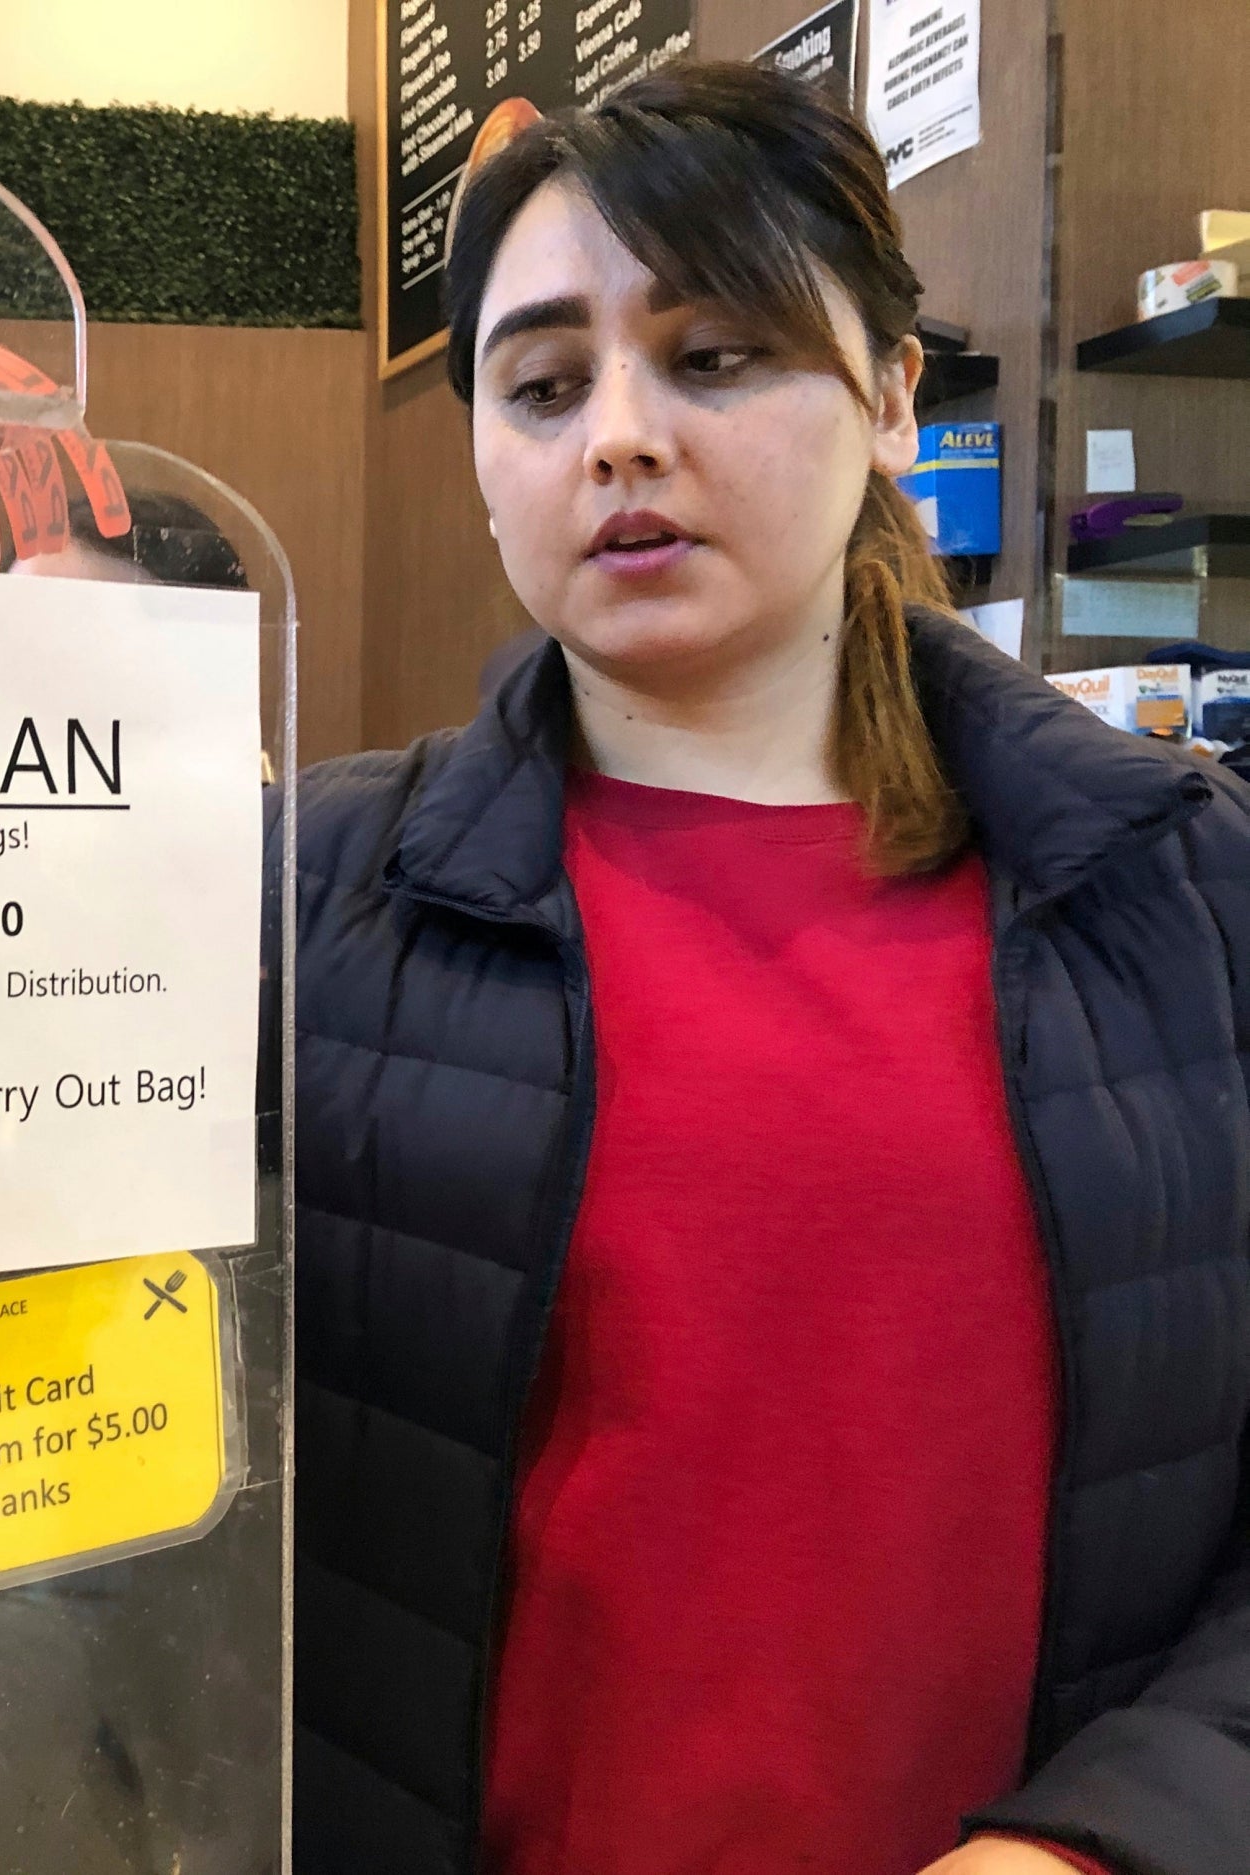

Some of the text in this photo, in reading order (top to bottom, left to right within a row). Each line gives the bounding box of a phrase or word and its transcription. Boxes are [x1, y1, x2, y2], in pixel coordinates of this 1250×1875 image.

[486, 26, 508, 59] 2.75
[576, 23, 613, 63] Vienna
[888, 13, 966, 71] ALCOHOLIC BEVERAGES
[909, 7, 943, 38] DRINKING
[518, 29, 541, 62] 3.50
[575, 36, 638, 95] Iced Coffee
[650, 30, 690, 71] Coffee
[884, 34, 969, 93] DURING PREGNANCY CAN
[486, 57, 508, 88] 3.00
[887, 58, 964, 111] CAUSE BIRTH DEFECTS
[401, 74, 457, 130] Hot Chocolate
[401, 103, 457, 157] Hot Chocolate
[1136, 666, 1179, 682] DayQuil
[7, 966, 167, 998] Distribution.
[56, 1074, 120, 1109] Out
[137, 1066, 205, 1111] Bag!
[25, 1364, 96, 1406] Card
[33, 1424, 78, 1458] for
[87, 1402, 168, 1451] $5.00
